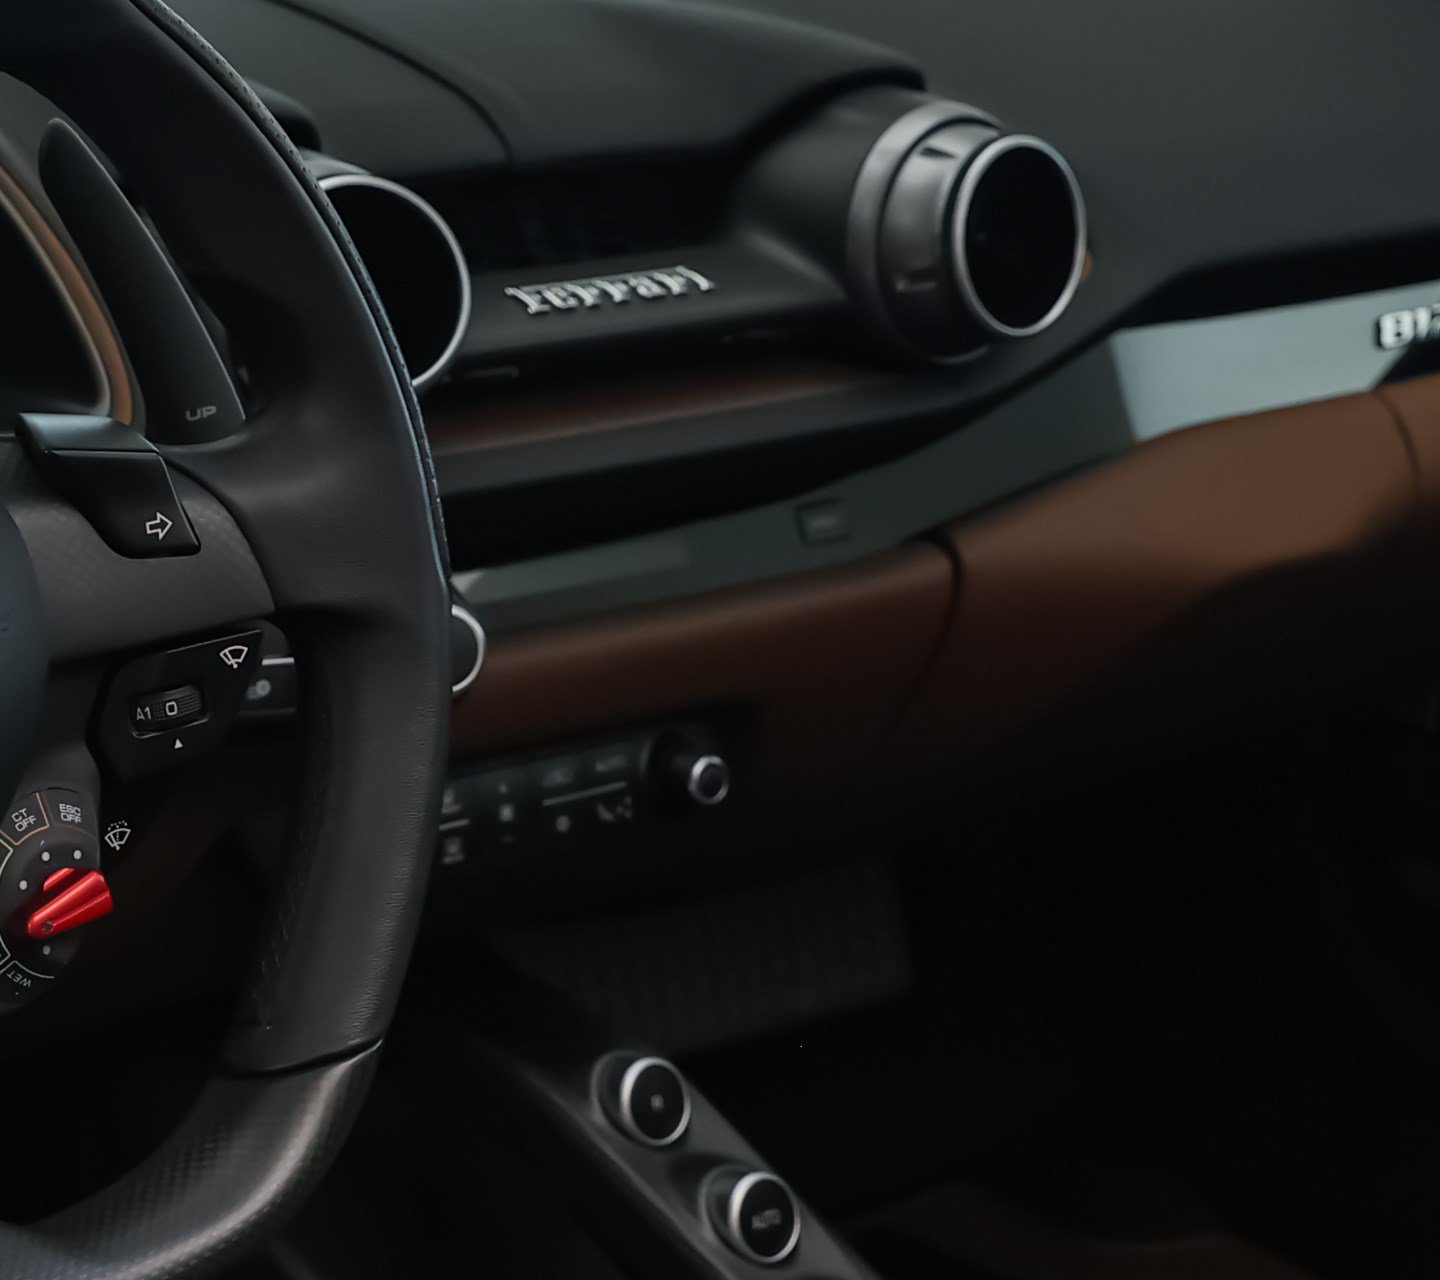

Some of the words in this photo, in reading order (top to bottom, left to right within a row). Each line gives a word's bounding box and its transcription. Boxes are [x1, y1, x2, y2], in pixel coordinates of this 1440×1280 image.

[504, 265, 715, 315] Ferrari
[185, 405, 217, 421] UP
[136, 706, 152, 721] A1
[11, 807, 28, 823] CT
[14, 815, 37, 832] OFF
[6, 970, 33, 988] WET
